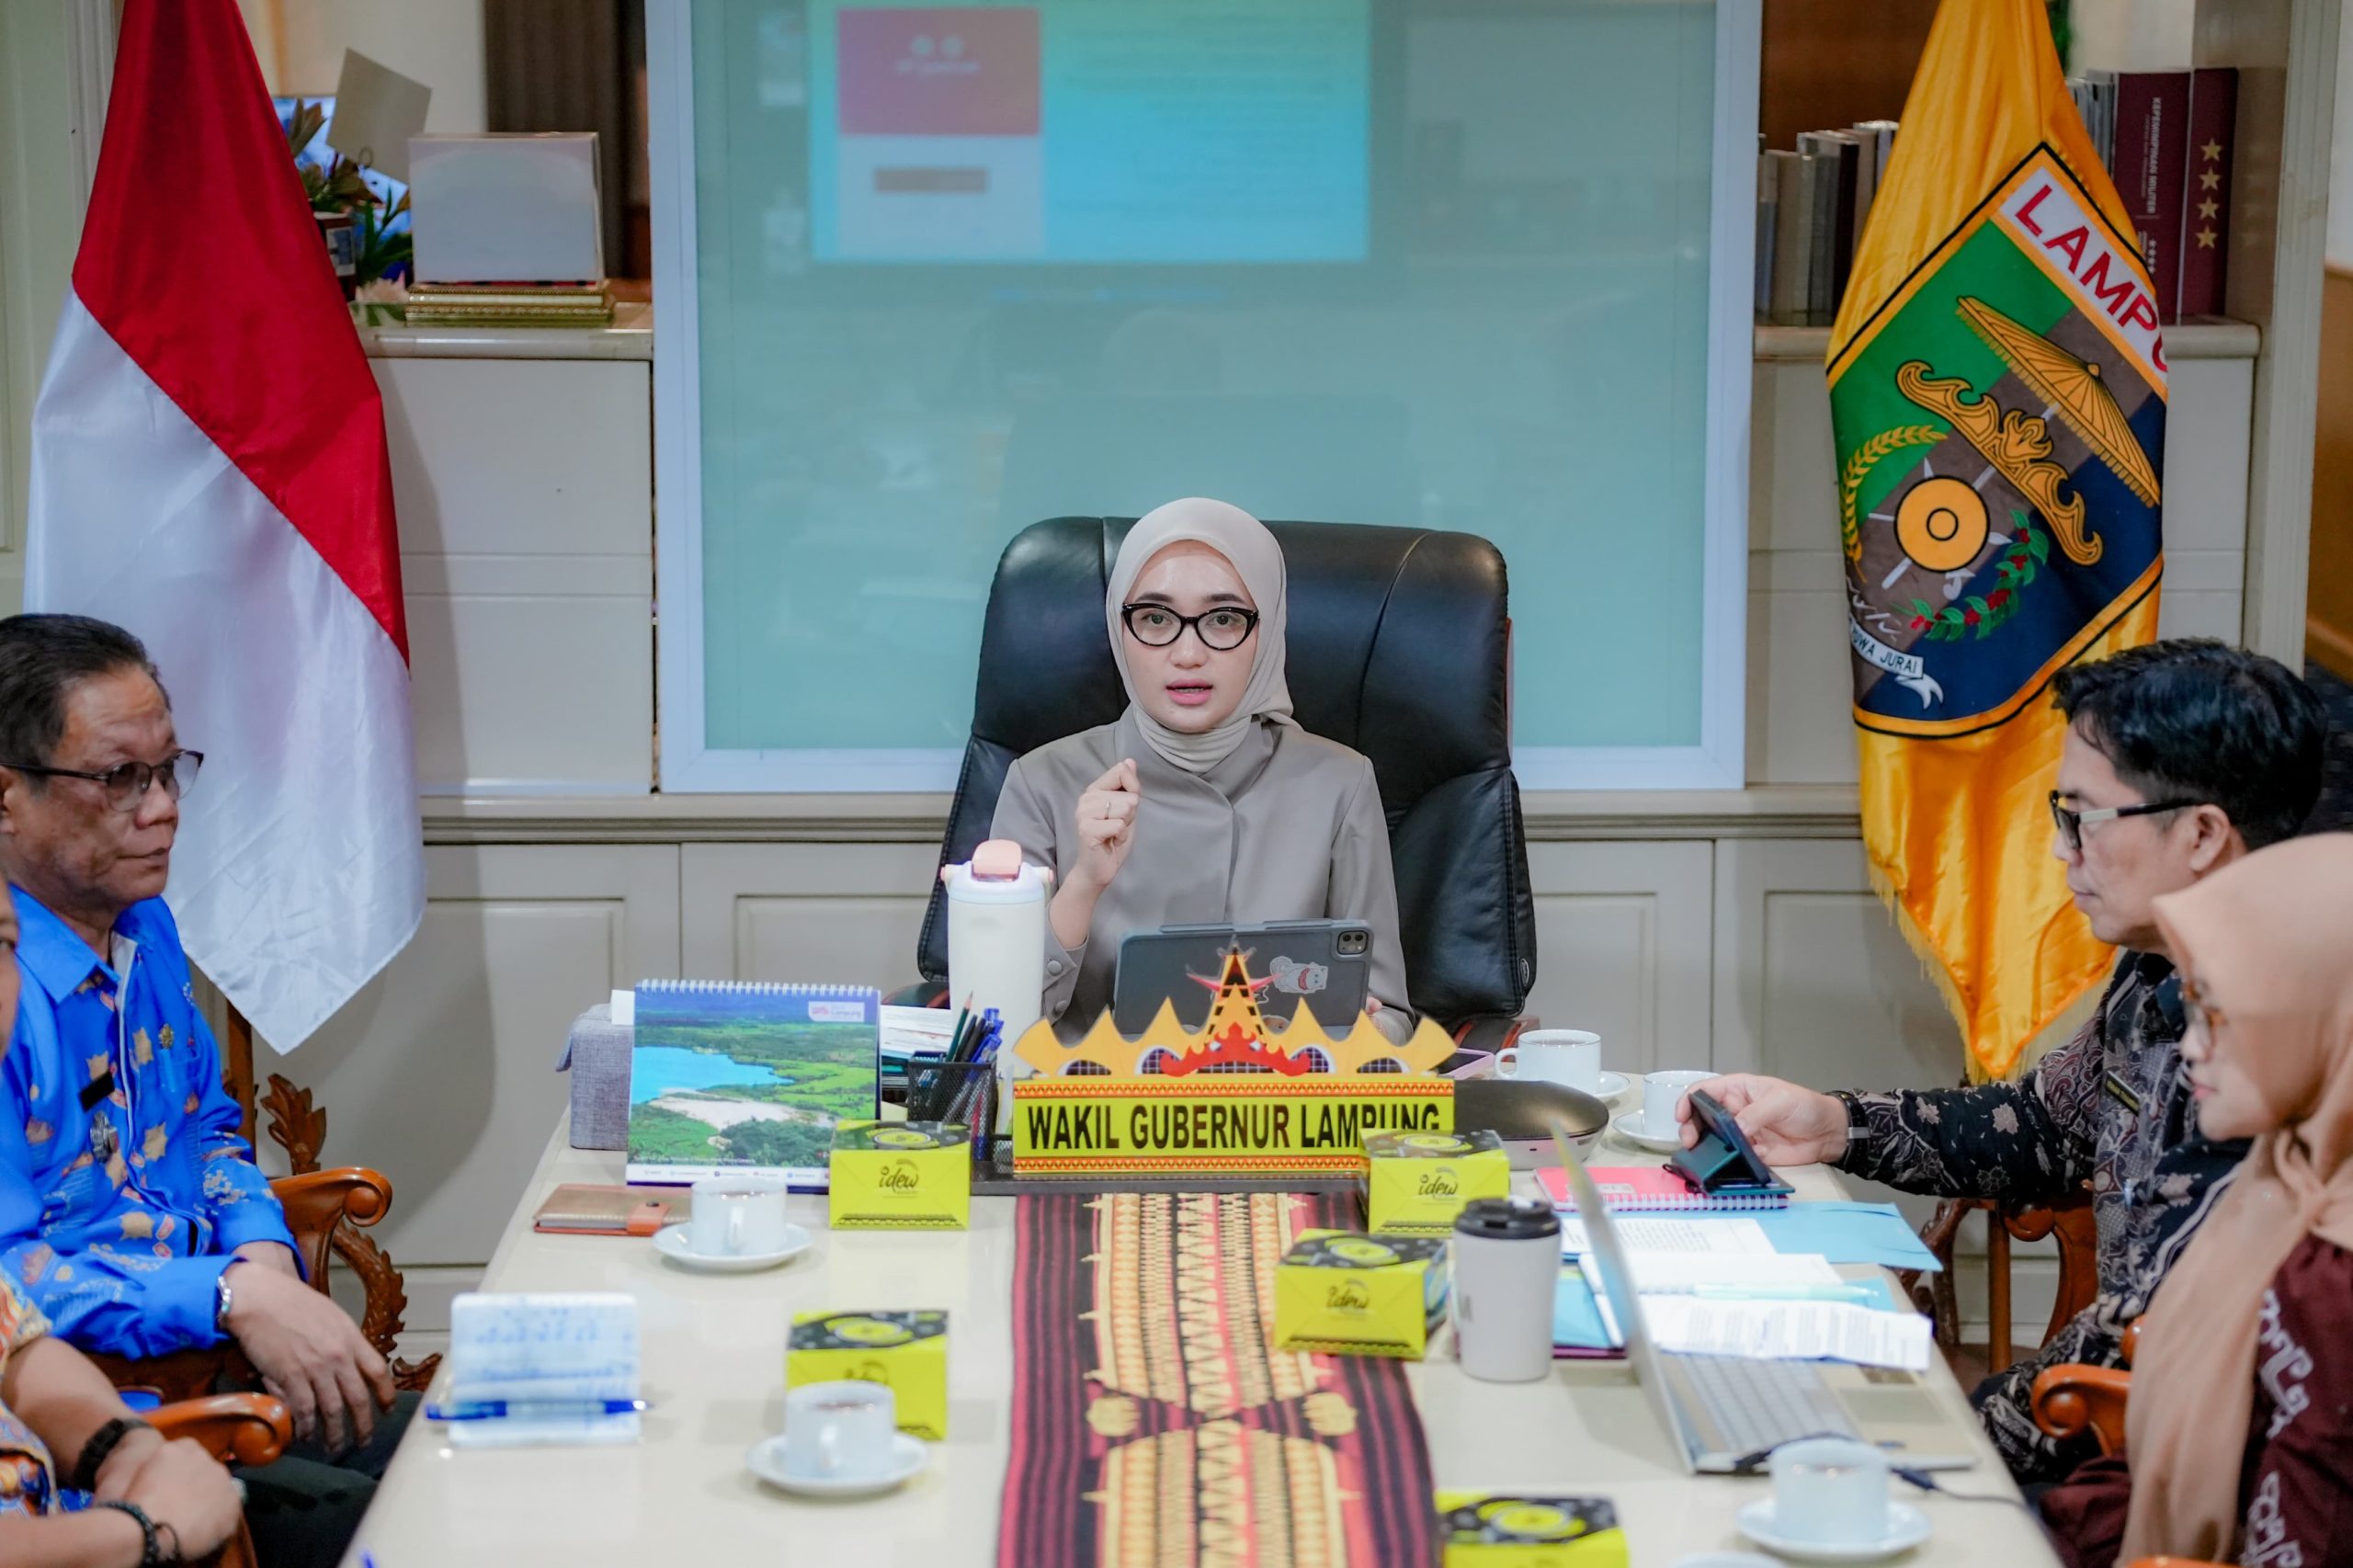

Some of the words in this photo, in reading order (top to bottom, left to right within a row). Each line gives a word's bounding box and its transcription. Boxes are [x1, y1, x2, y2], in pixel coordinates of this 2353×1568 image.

[1880, 652, 1917, 674] JURAI
[1028, 1105, 1120, 1149] WAKIL
[1130, 1104, 1290, 1149] GUBERNUR
